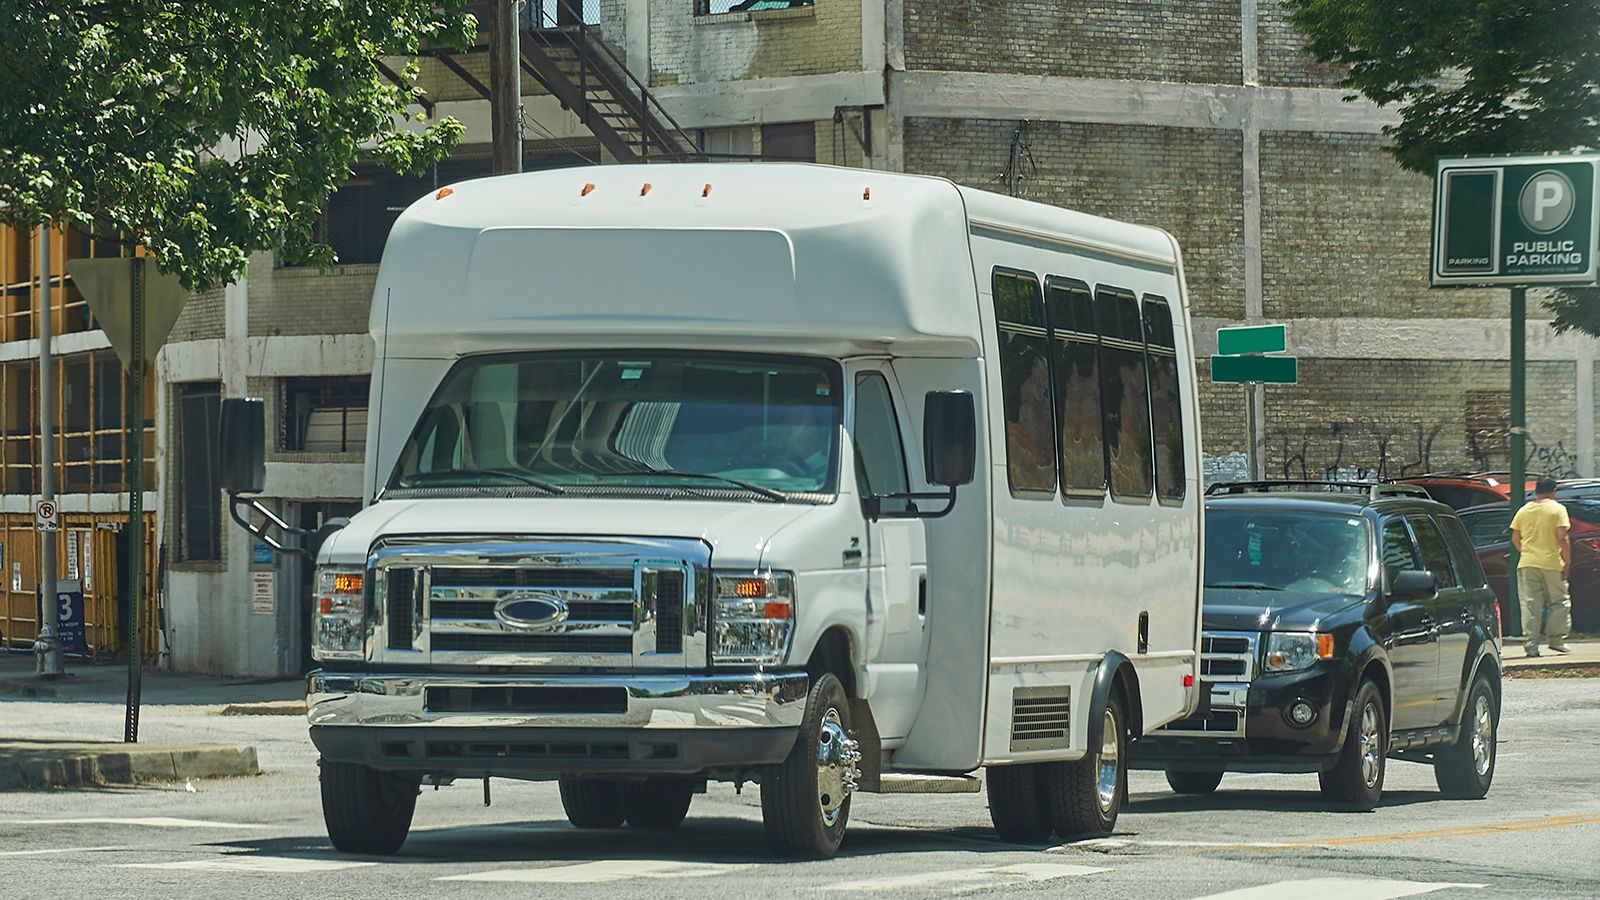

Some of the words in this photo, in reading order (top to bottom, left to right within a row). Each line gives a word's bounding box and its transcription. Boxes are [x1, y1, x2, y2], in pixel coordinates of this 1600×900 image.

[1534, 181, 1564, 222] P
[1513, 240, 1574, 253] PUBLIC
[1448, 257, 1489, 265] PARKING
[1506, 253, 1582, 266] PARKING
[59, 594, 73, 621] 3
